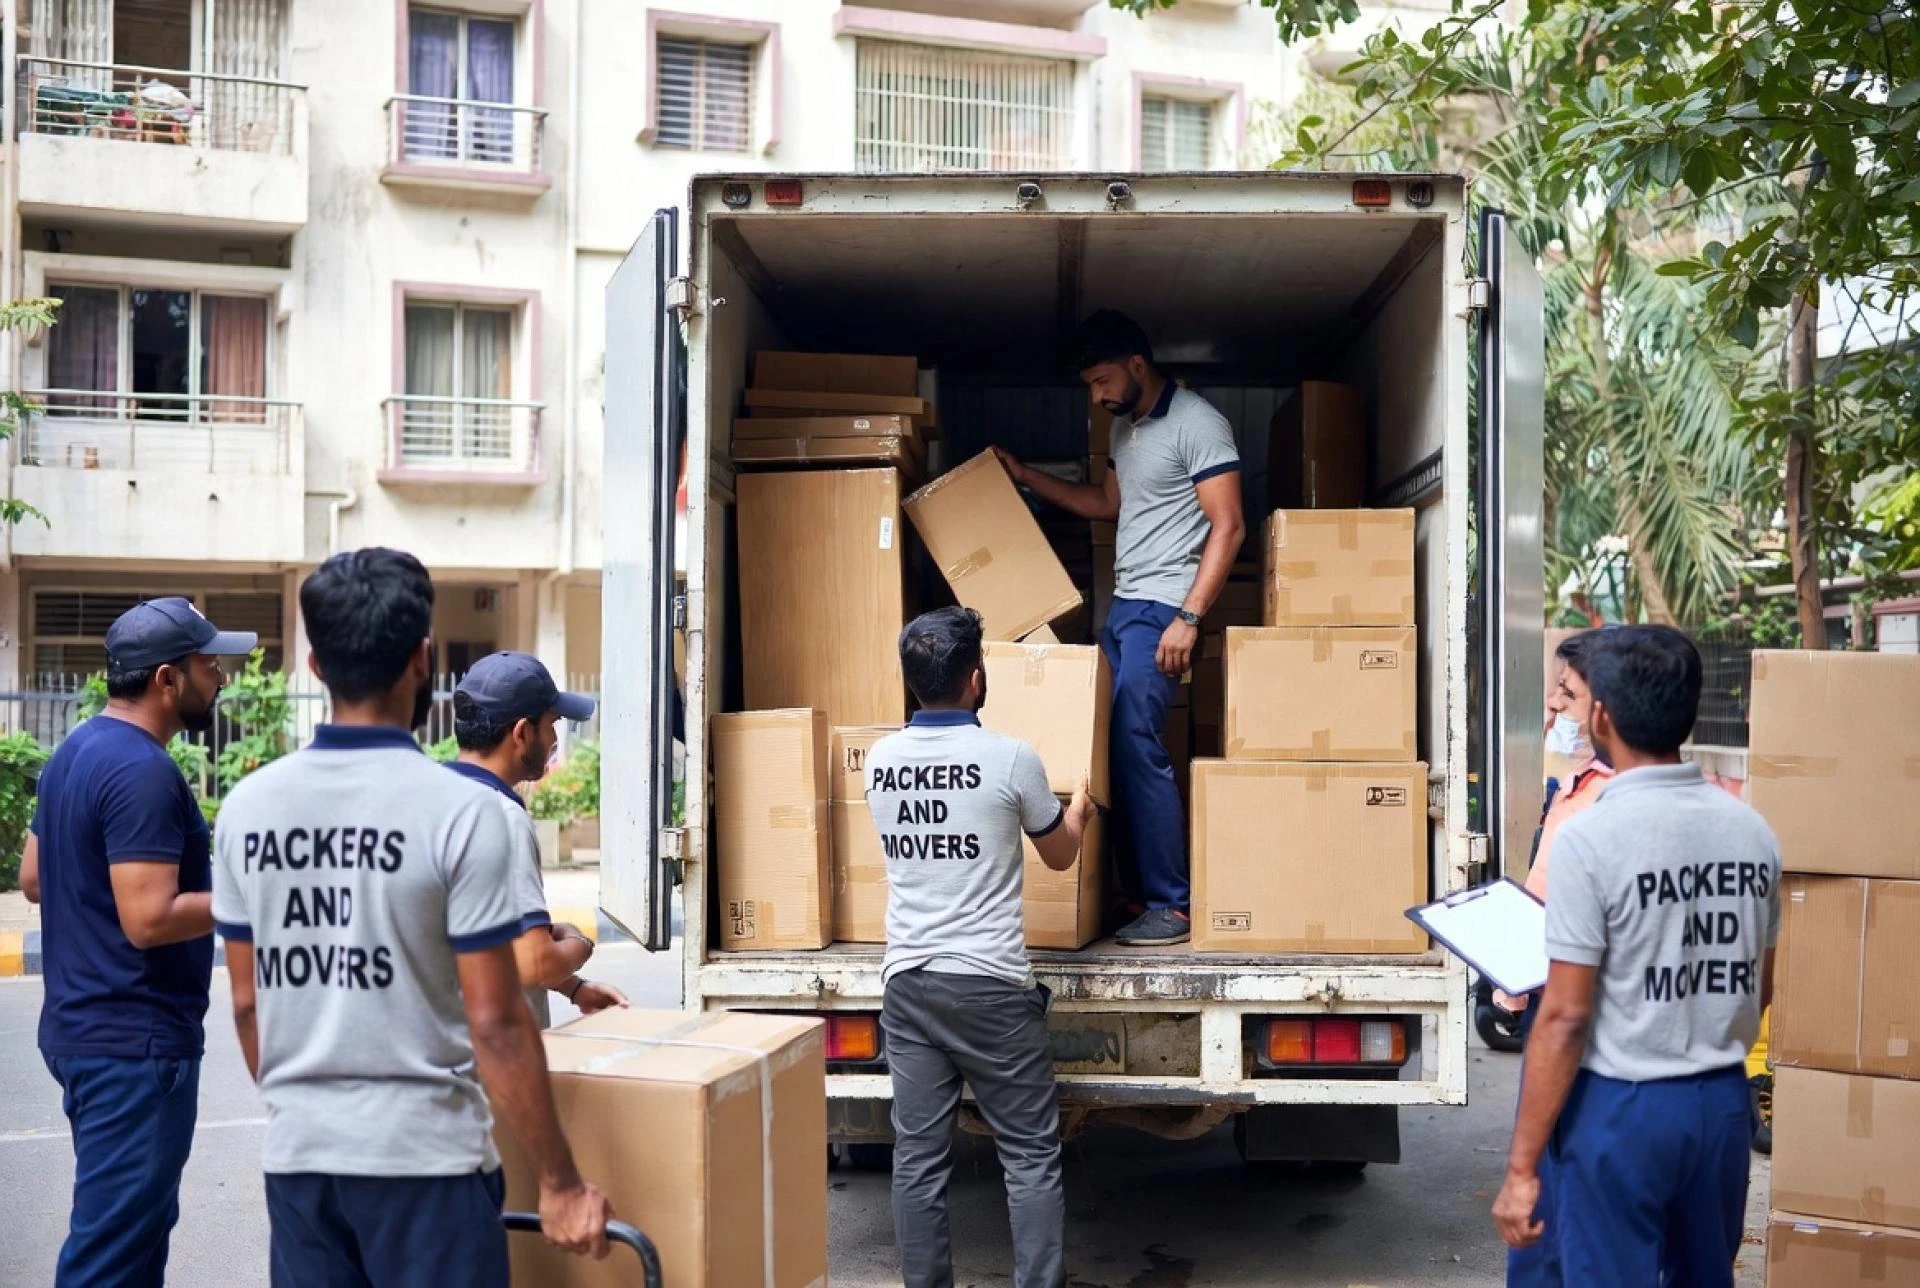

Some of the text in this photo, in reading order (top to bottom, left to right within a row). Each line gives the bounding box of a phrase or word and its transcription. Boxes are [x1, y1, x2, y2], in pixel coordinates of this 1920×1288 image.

[872, 763, 981, 792] PACKERS
[897, 799, 948, 825] AND
[244, 827, 406, 874] PACKERS
[1637, 861, 1769, 910] PACKERS
[283, 886, 352, 928] AND
[1681, 911, 1740, 947] AND
